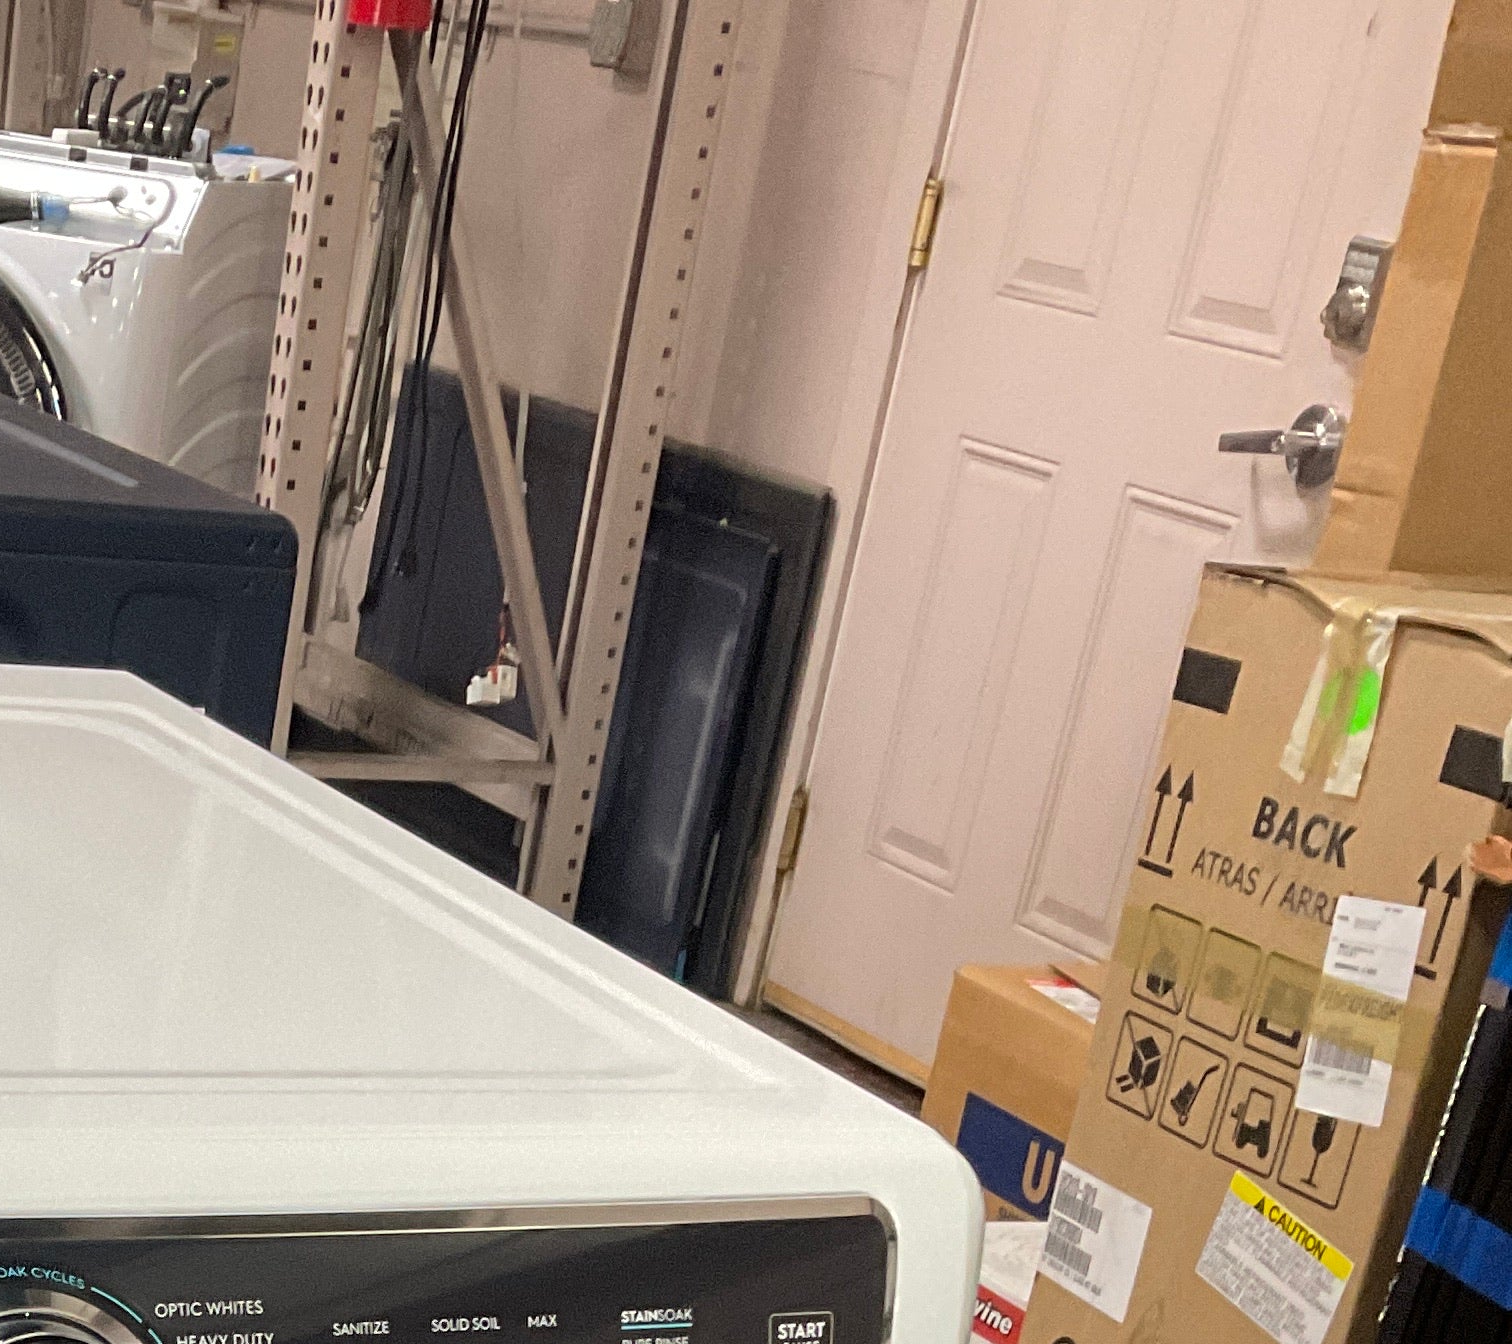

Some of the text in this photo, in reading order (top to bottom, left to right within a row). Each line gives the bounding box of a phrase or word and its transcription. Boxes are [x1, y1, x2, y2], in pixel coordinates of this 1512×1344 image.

[1252, 796, 1358, 869] BACK
[1191, 847, 1261, 896] ATRAS
[1278, 881, 1339, 927] ARRI
[1268, 1205, 1327, 1261] CAUTION
[30, 1267, 86, 1290] CYCLES
[154, 1300, 264, 1318] OPTIC WHITES
[620, 1308, 693, 1324] STAINSOAK
[332, 1321, 390, 1336] SANITIZE
[431, 1316, 501, 1333] SOLID SOIL
[527, 1314, 558, 1328] MAX
[777, 1321, 826, 1340] START
